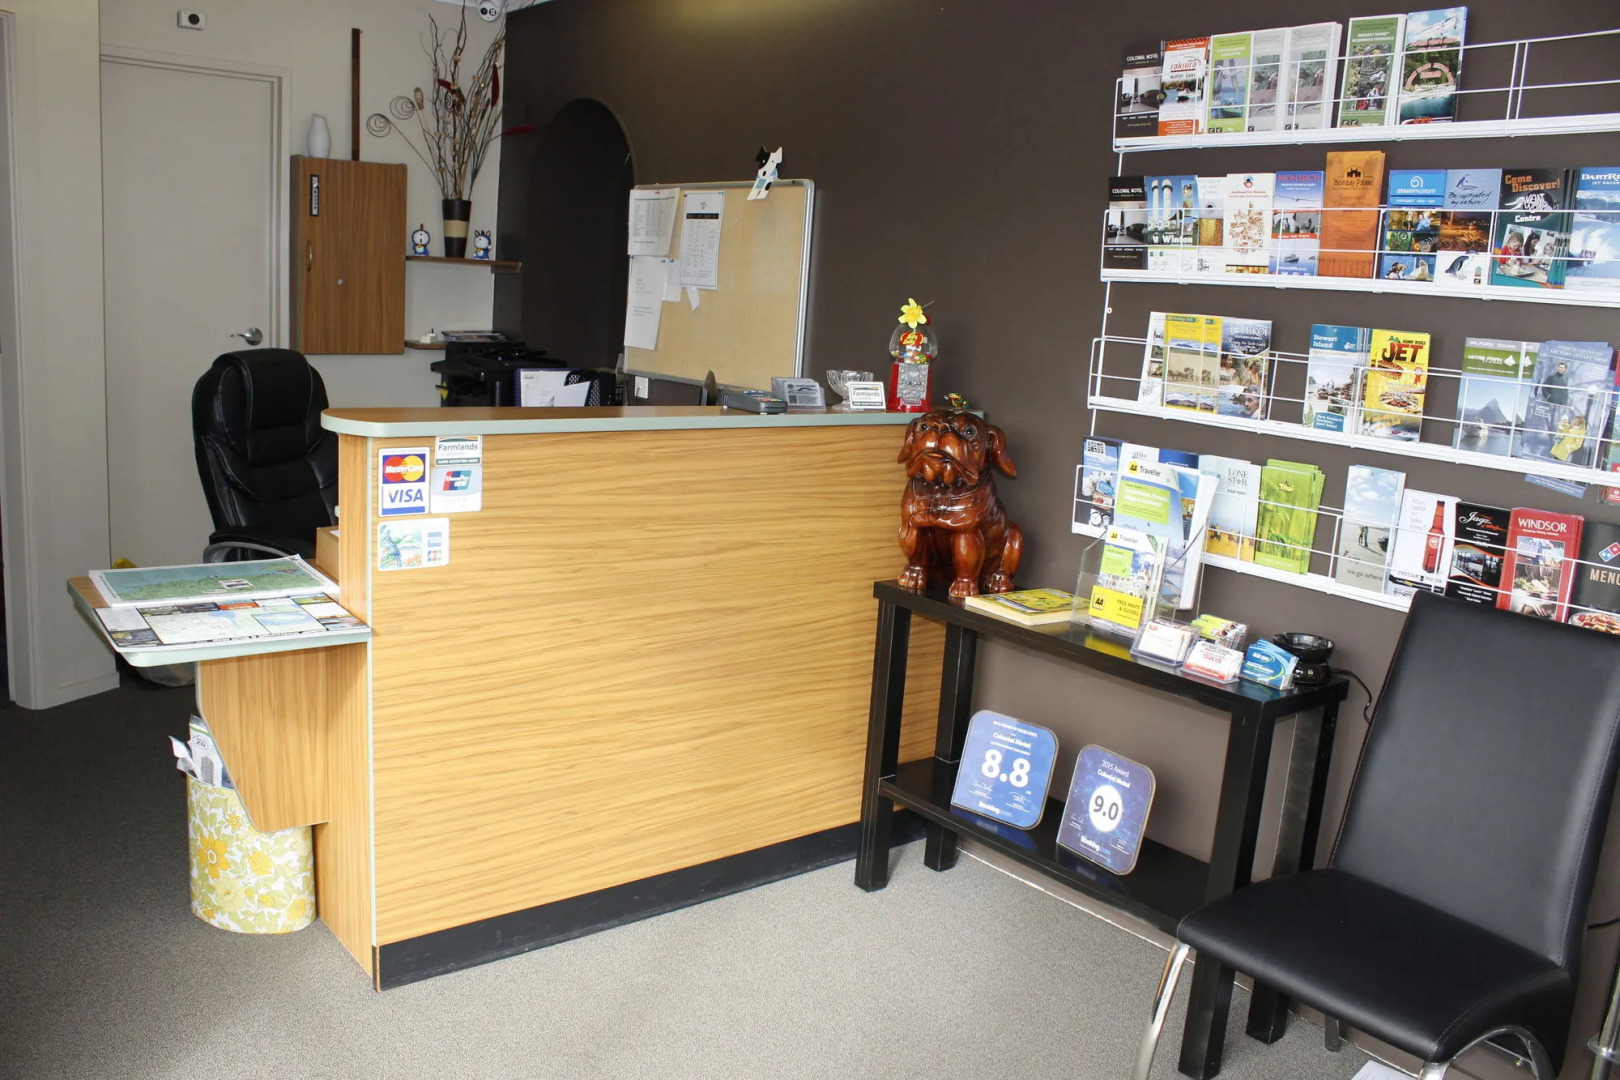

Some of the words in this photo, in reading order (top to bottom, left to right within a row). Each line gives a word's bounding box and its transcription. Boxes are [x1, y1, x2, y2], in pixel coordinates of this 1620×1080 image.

[1170, 61, 1197, 69] rakiura
[1334, 179, 1355, 187] Bombay
[1356, 178, 1373, 187] Palace
[1505, 174, 1532, 184] Come
[1512, 179, 1560, 192] Discover!
[1458, 191, 1493, 199] captivated
[1162, 235, 1193, 243] Winton
[1382, 342, 1424, 363] JET
[438, 443, 478, 452] Farmlands
[385, 465, 424, 474] MasterCard
[1140, 466, 1161, 477] Traveller
[1228, 469, 1248, 478] LONE
[388, 489, 423, 503] VISA
[1458, 511, 1492, 526] Jagz
[1518, 518, 1567, 533] WINDSOR
[1120, 535, 1138, 543] Traveller
[1365, 573, 1383, 581] where
[1095, 597, 1104, 606] AA
[1123, 608, 1139, 616] GUIDES
[993, 732, 1015, 743] Colonial
[1016, 739, 1031, 748] Motel
[981, 749, 1031, 788] 8.8
[1101, 760, 1114, 770] 2015
[1114, 766, 1129, 777] Award
[1097, 769, 1116, 782] Colonial
[1116, 777, 1131, 788] Motel
[978, 801, 1012, 817] Booking.com
[1093, 795, 1119, 821] 9.0
[1080, 835, 1111, 856] Booking.com
